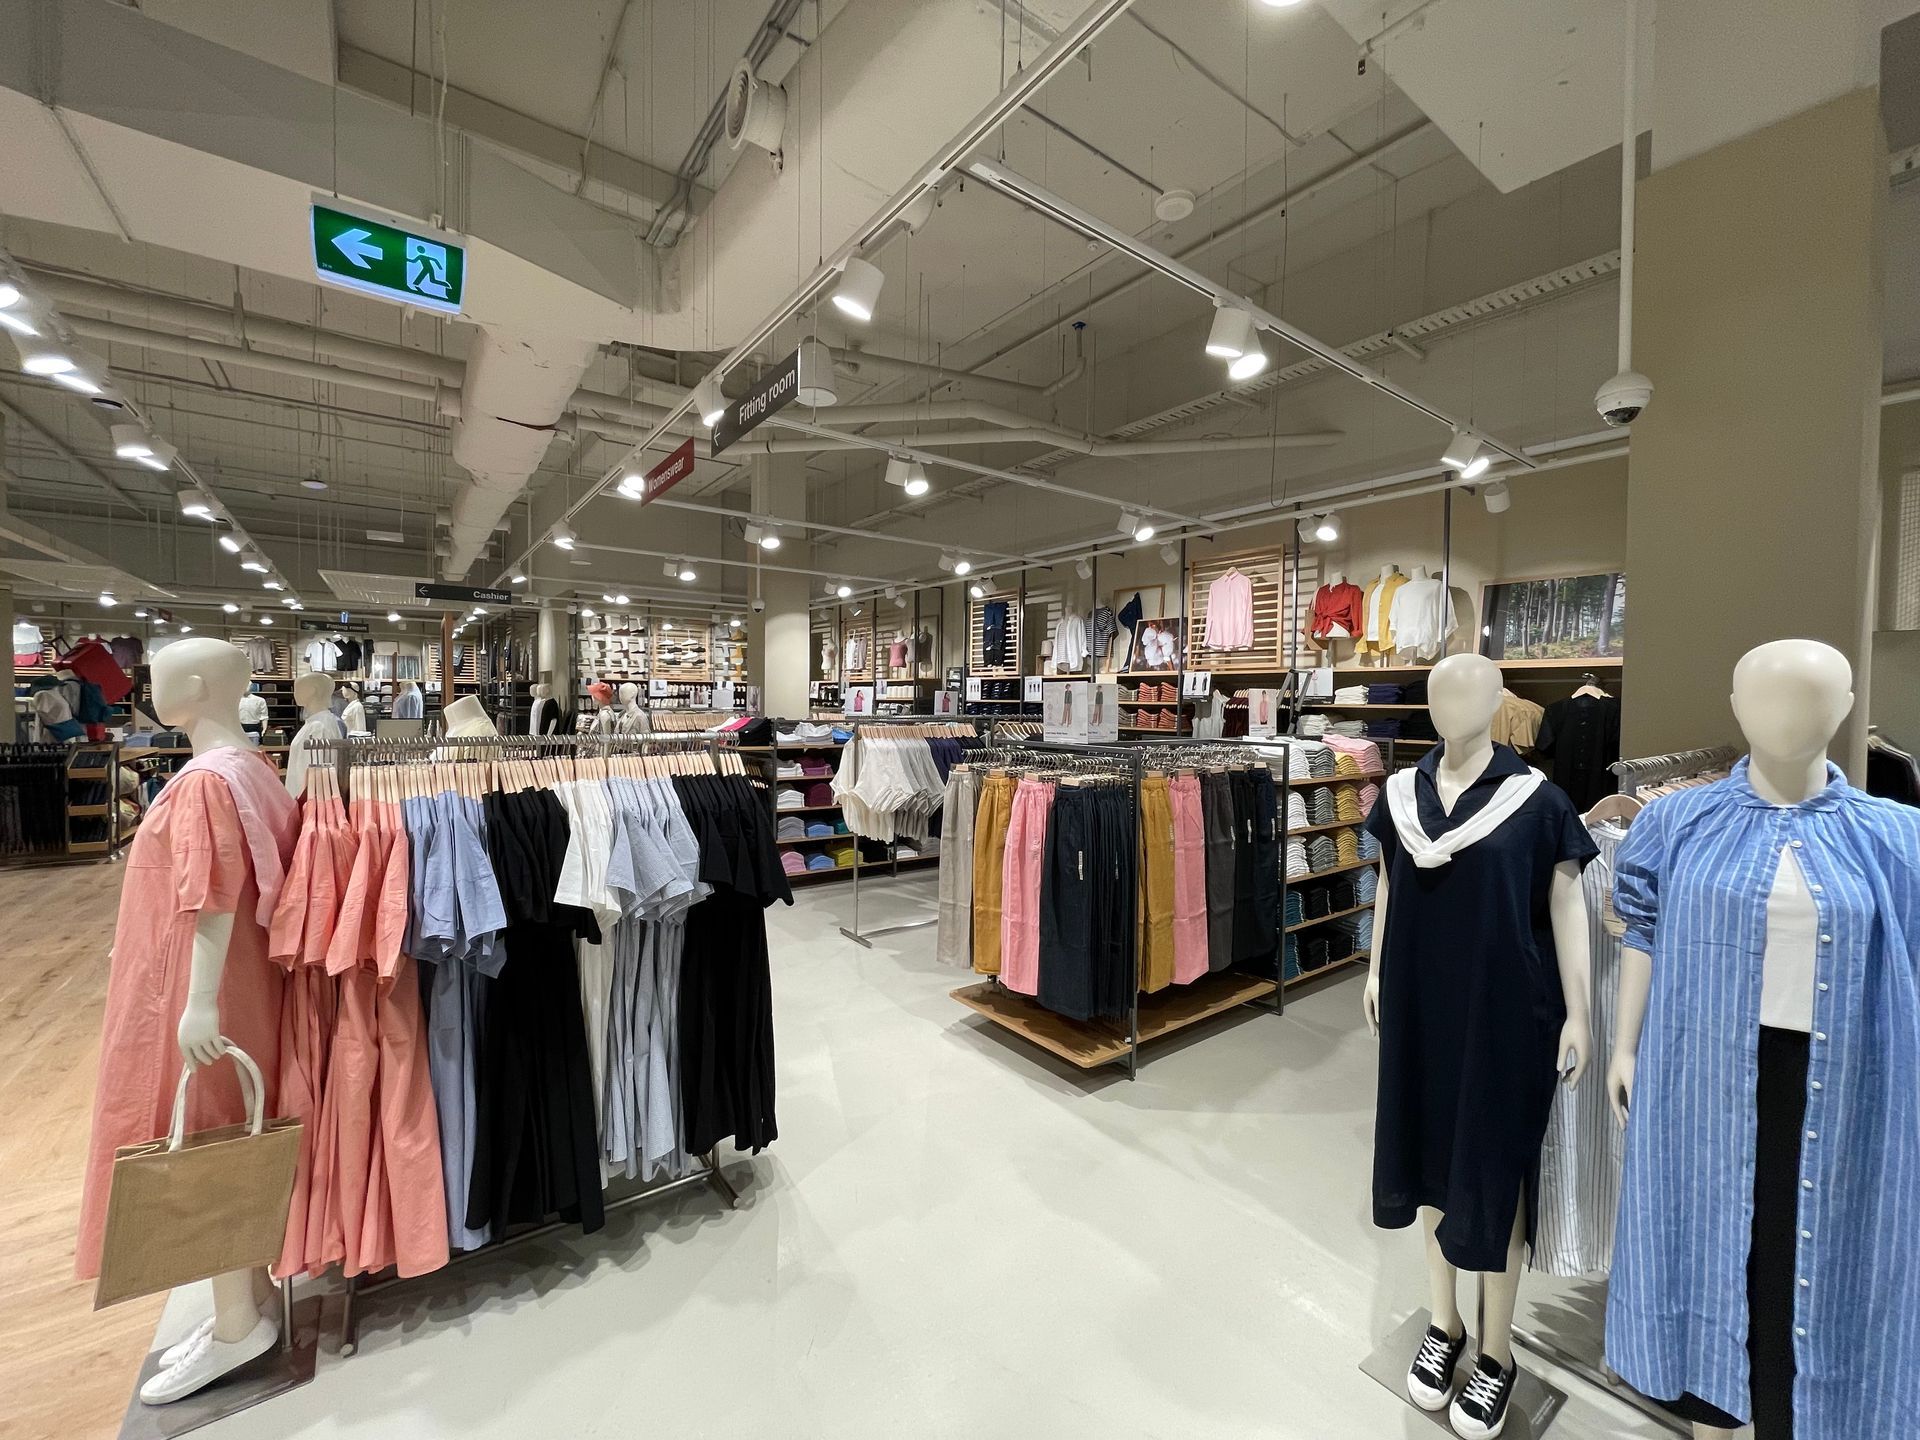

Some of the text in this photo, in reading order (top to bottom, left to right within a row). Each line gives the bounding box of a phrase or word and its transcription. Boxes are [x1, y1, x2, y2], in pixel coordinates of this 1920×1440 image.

[739, 369, 795, 425] Fitting room
[648, 456, 685, 493] Womenswear
[473, 591, 508, 600] Cashier
